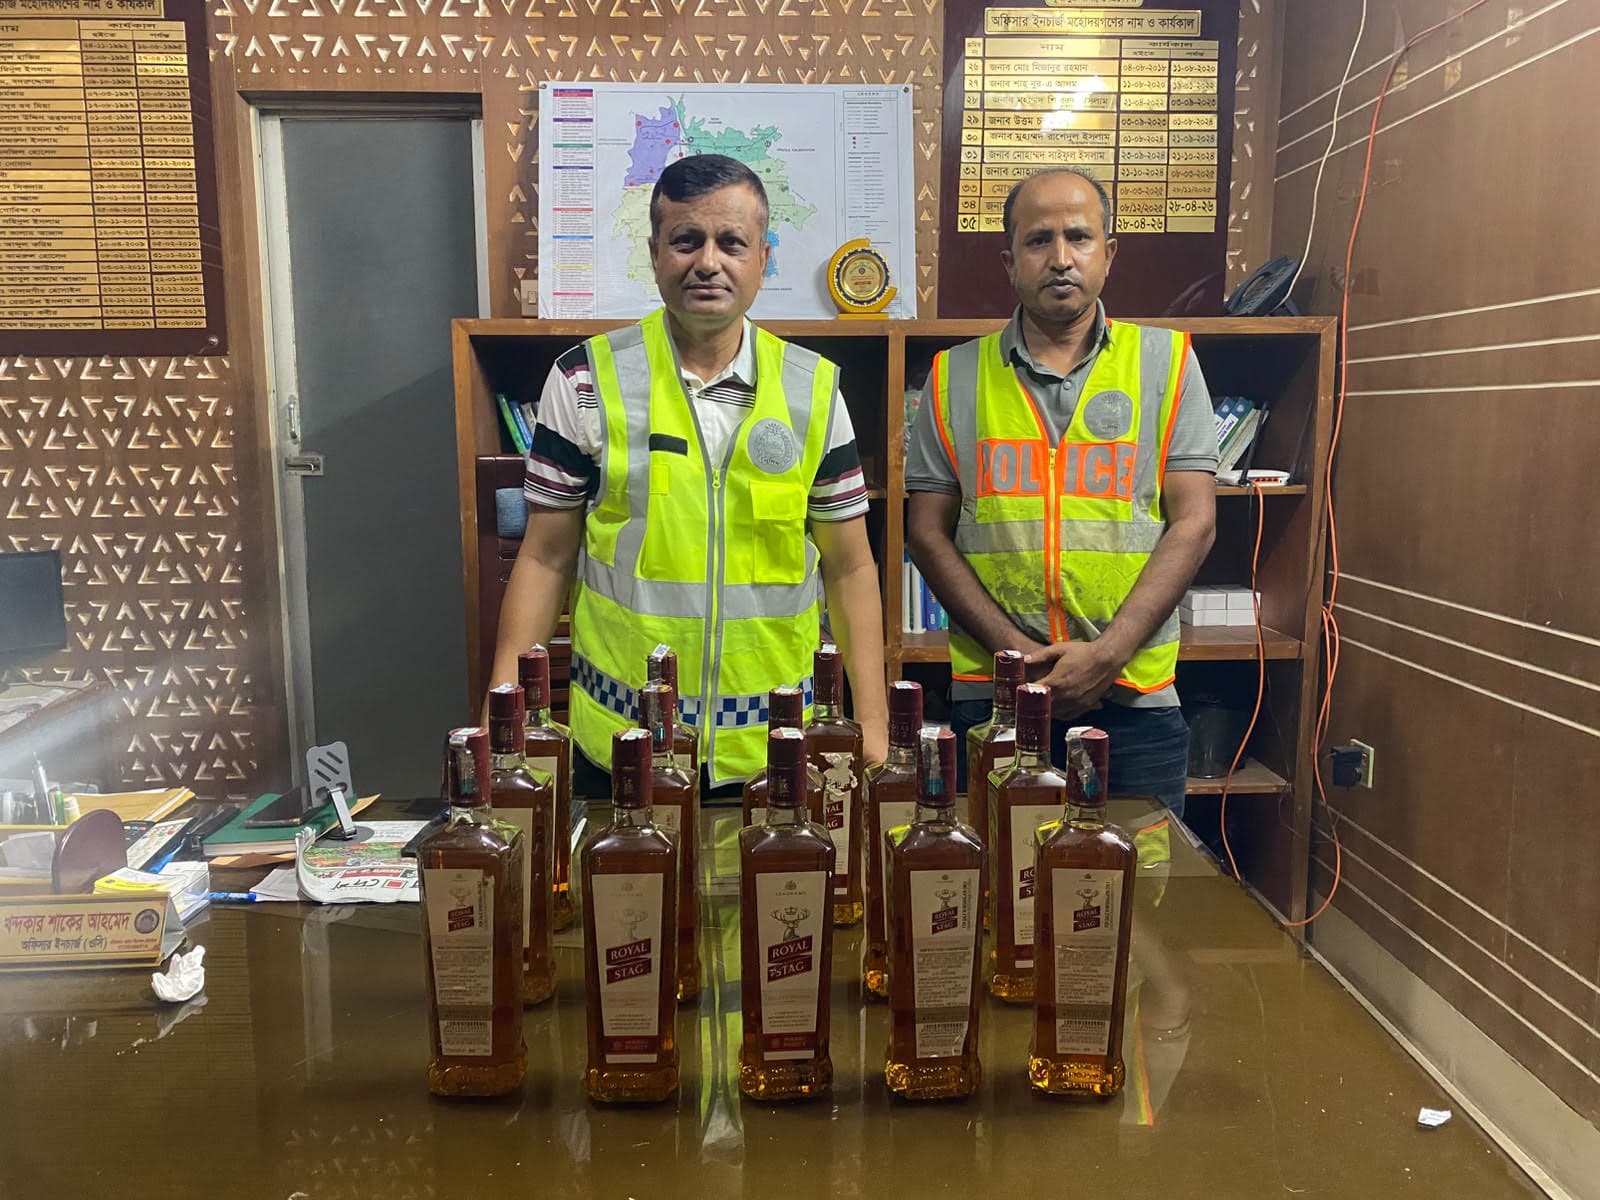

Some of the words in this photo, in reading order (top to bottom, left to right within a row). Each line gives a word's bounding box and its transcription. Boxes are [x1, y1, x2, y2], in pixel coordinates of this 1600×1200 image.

[991, 12, 1029, 27] অফিসার
[1031, 13, 1064, 28] ইনচার্জ
[1066, 14, 1124, 28] মহোদয়গণের
[1127, 17, 1144, 28] নাম
[1148, 18, 1156, 28] ও
[1158, 15, 1195, 30] কার্যকাল
[968, 63, 978, 71] ২৬
[990, 64, 1011, 72] জনাব
[1063, 64, 1088, 72] রহমান
[1173, 64, 1216, 73] ১১-০৮-২০২০
[968, 79, 979, 87] ২৭
[990, 79, 1011, 88] জনাব
[967, 117, 979, 126] ২৯
[988, 117, 1011, 125] জনাব
[1013, 115, 1034, 126] উত্তম
[990, 133, 1013, 141] জনাব
[1082, 131, 1110, 141] ইসলাম
[965, 152, 977, 160] ৩১
[989, 151, 1010, 160] জনাব
[1013, 151, 1046, 160] মোহাম্মদ
[1048, 149, 1076, 161] সাইফুল
[1079, 149, 1105, 160] ইসলাম
[963, 167, 977, 175] ৩২
[985, 167, 1008, 176] জনাব
[1121, 168, 1164, 177] ২১-১০-২০২৪
[961, 201, 976, 209] ৩৪
[1169, 200, 1214, 213] ২৮-০৪-২৬
[960, 217, 977, 230] ৩৫
[1117, 217, 1163, 231] ২৮-০৪-২৬
[1076, 908, 1098, 918] ROYAL
[4, 915, 46, 934] খন্দকার
[48, 913, 84, 934] শাকের
[87, 912, 132, 933] আহমেদ
[1078, 920, 1096, 929] STAG
[21, 937, 52, 951] অফিসার
[772, 940, 809, 959] ROYAL
[610, 943, 648, 961] ROYAL
[614, 964, 644, 979] STAG
[775, 961, 805, 977] STAG
